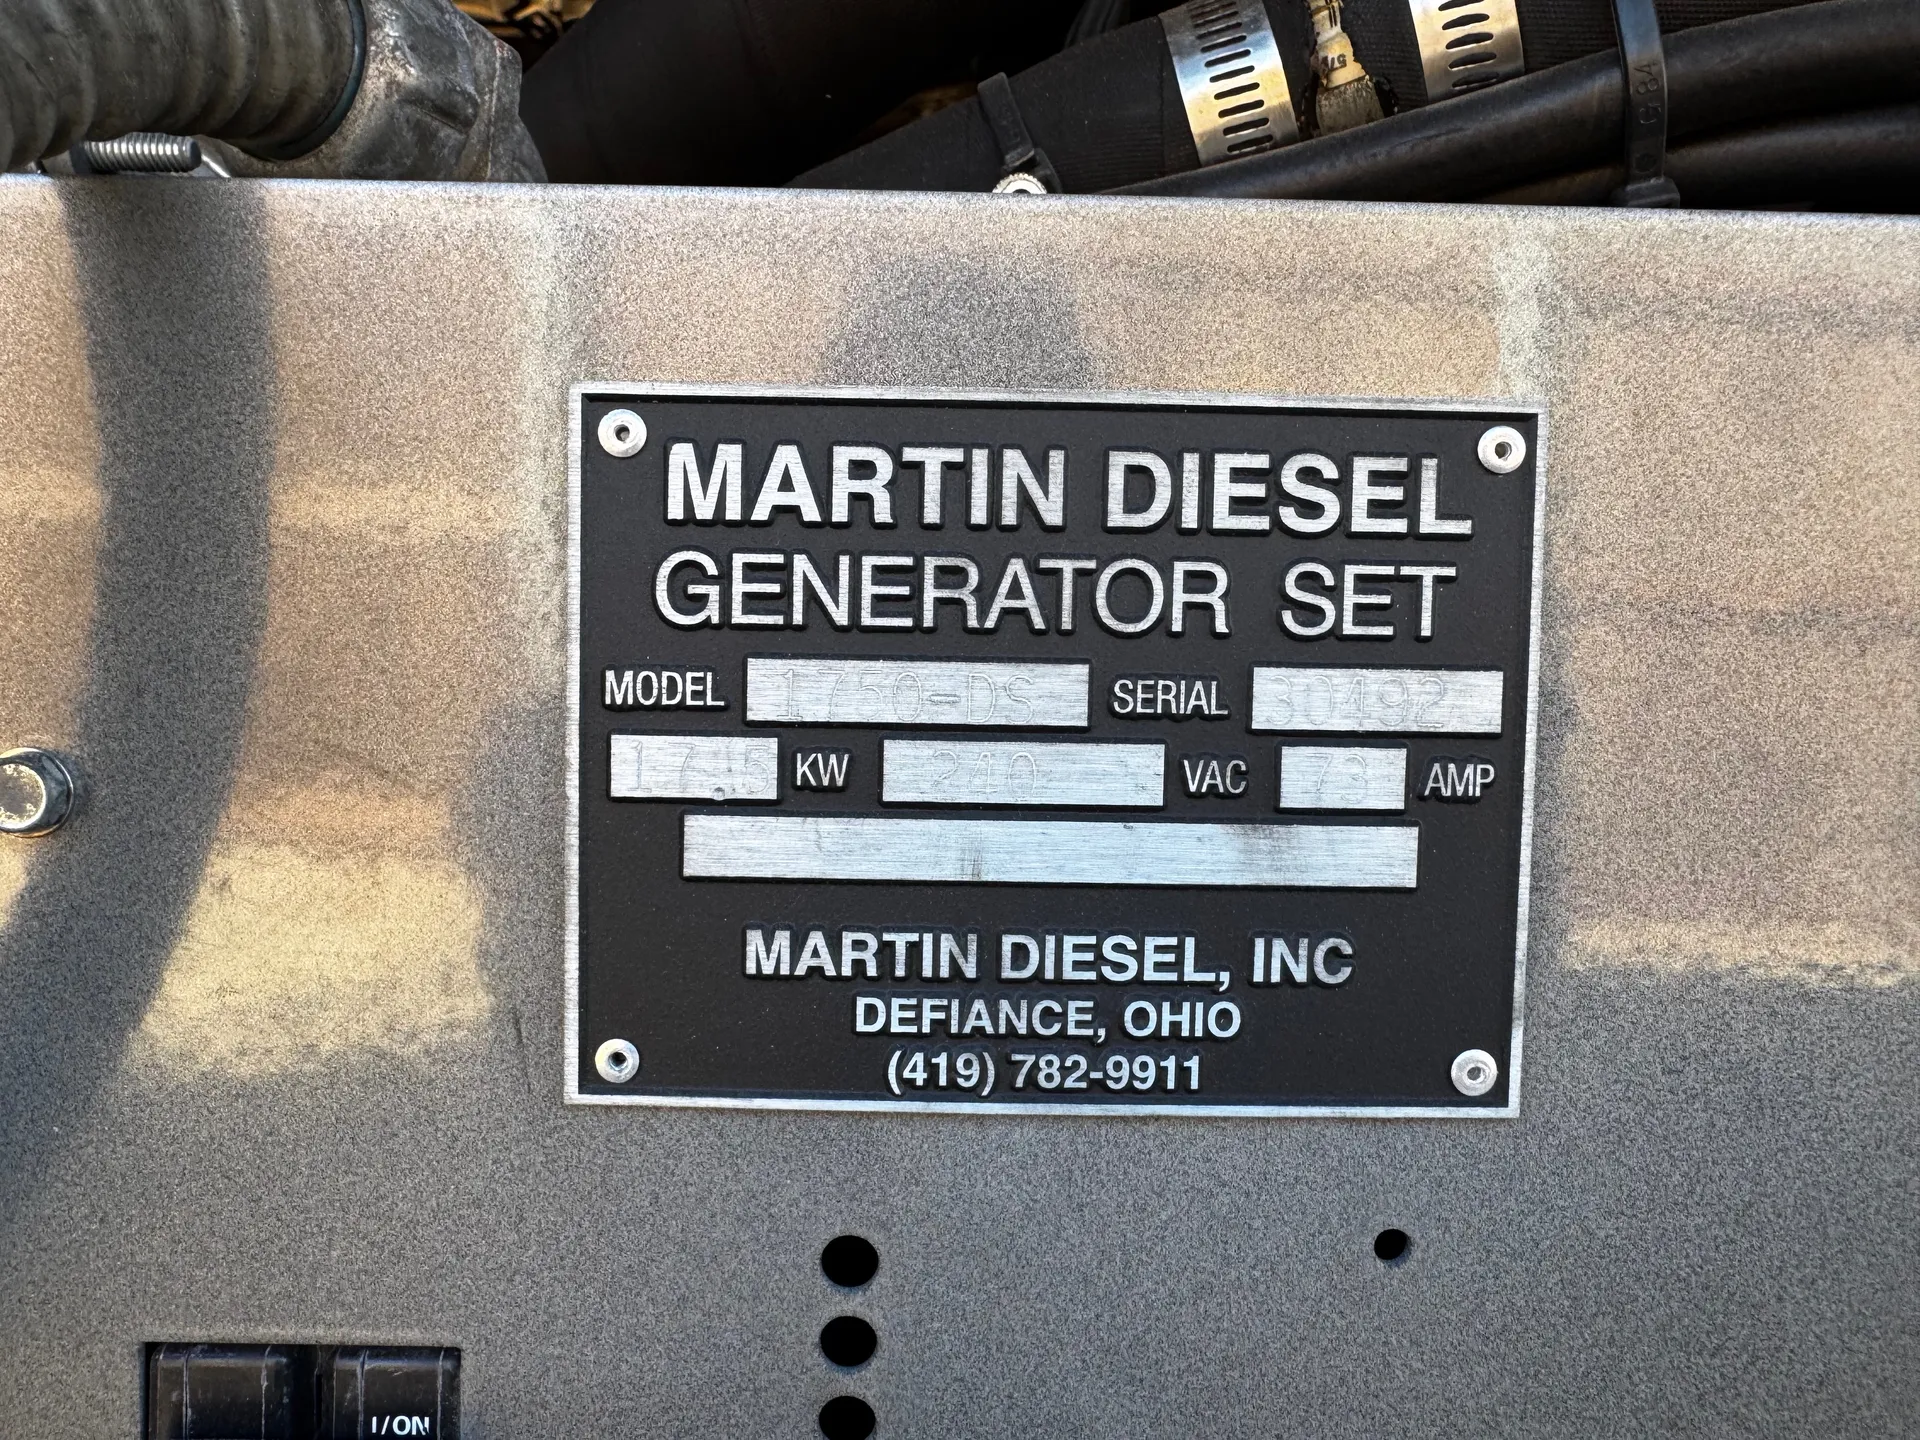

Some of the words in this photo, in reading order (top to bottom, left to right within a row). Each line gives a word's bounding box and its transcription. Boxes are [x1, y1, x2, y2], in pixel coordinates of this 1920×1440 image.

[667, 443, 1065, 527] MARTIN
[1107, 450, 1472, 536] DIESEL
[655, 550, 1230, 635] GENERATOR
[1281, 562, 1457, 638] SET
[604, 669, 725, 707] MODEL
[776, 668, 1036, 725] 1750-DS
[1113, 679, 1229, 716] SERIAL
[1269, 675, 1446, 729] 30492
[796, 752, 850, 787] KW
[932, 750, 1037, 795] 240
[1183, 759, 1248, 794] VAC
[1305, 753, 1369, 805] 73
[1423, 762, 1495, 797] AMP
[745, 929, 980, 981] MARTIN
[1000, 934, 1230, 991] DIESEL,
[1253, 937, 1354, 985] INC
[855, 996, 1106, 1043] DEFIANCE,
[1123, 1000, 1242, 1039] OHIO
[887, 1050, 996, 1097] (419)
[1010, 1053, 1201, 1091] 782-9911
